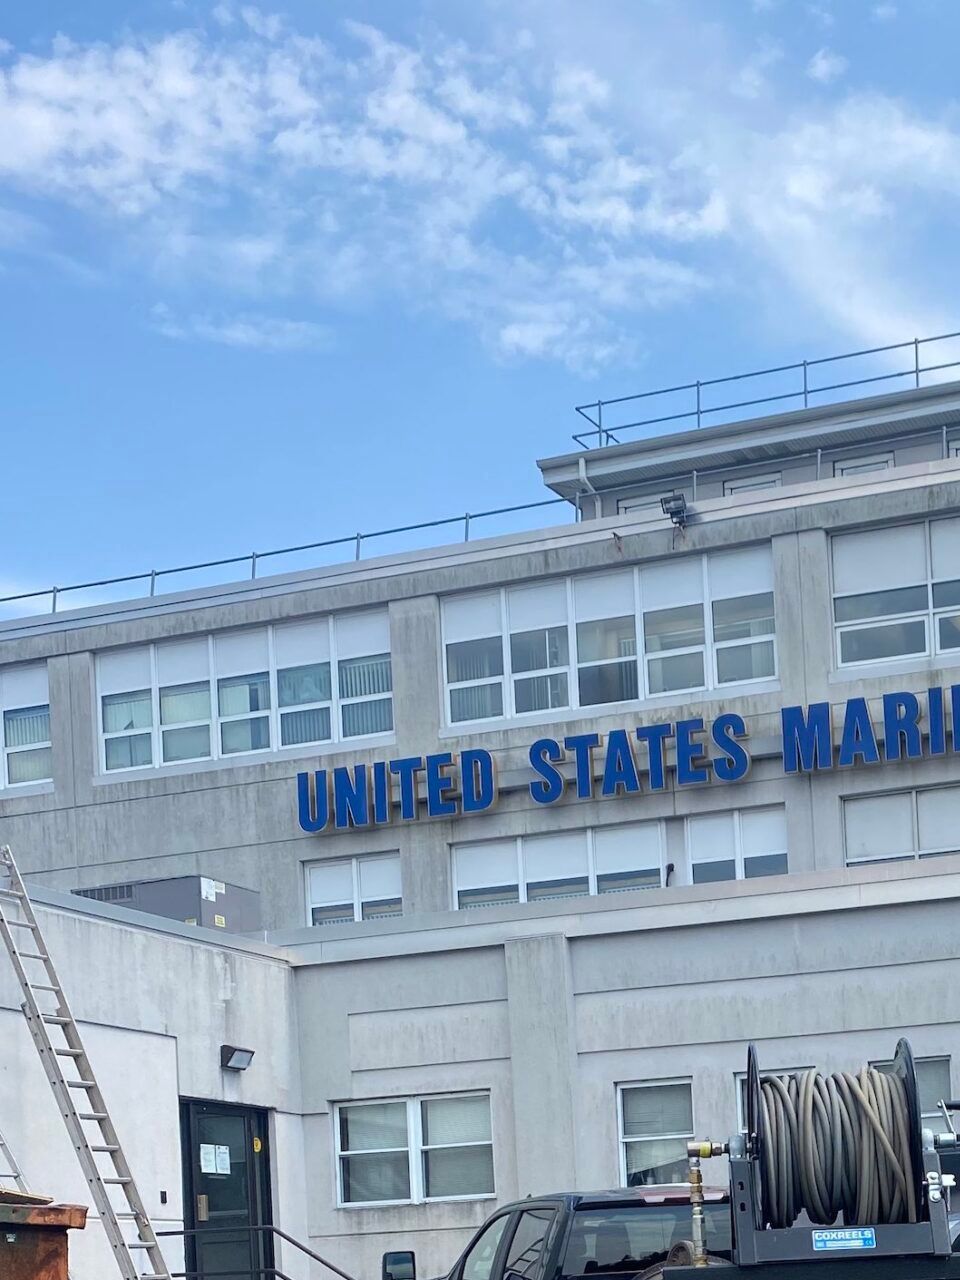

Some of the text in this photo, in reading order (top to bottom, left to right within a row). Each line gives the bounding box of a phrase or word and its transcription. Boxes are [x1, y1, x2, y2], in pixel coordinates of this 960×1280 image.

[297, 748, 496, 834] UNITED
[529, 712, 751, 804] STATES
[815, 1230, 872, 1240] COXREELS
